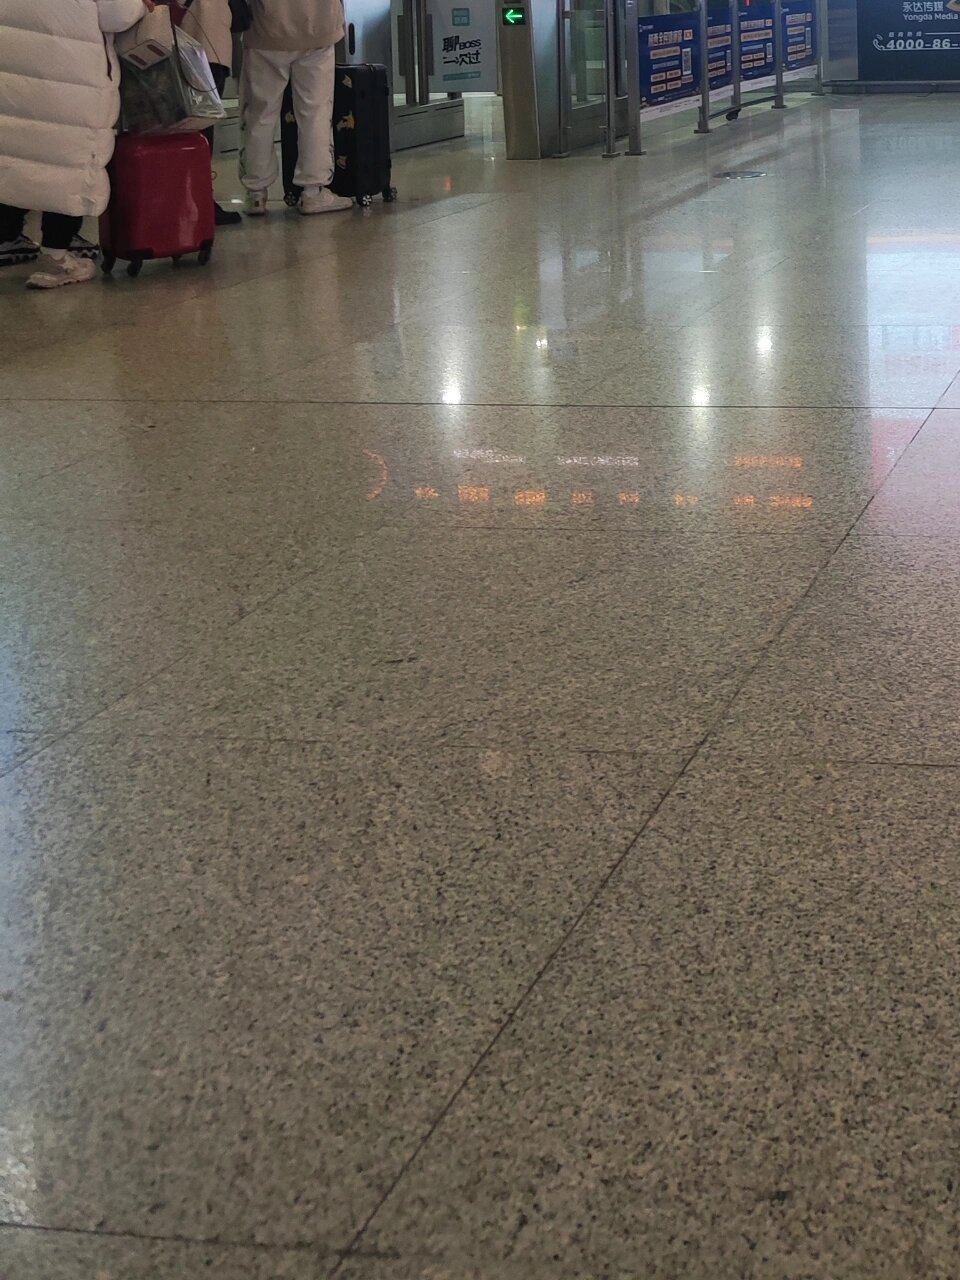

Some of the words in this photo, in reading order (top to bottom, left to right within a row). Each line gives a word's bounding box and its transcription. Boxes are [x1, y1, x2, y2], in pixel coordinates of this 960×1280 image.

[902, 1, 944, 12] 永达传媒
[903, 13, 933, 22] Yongda
[934, 12, 959, 20] Media
